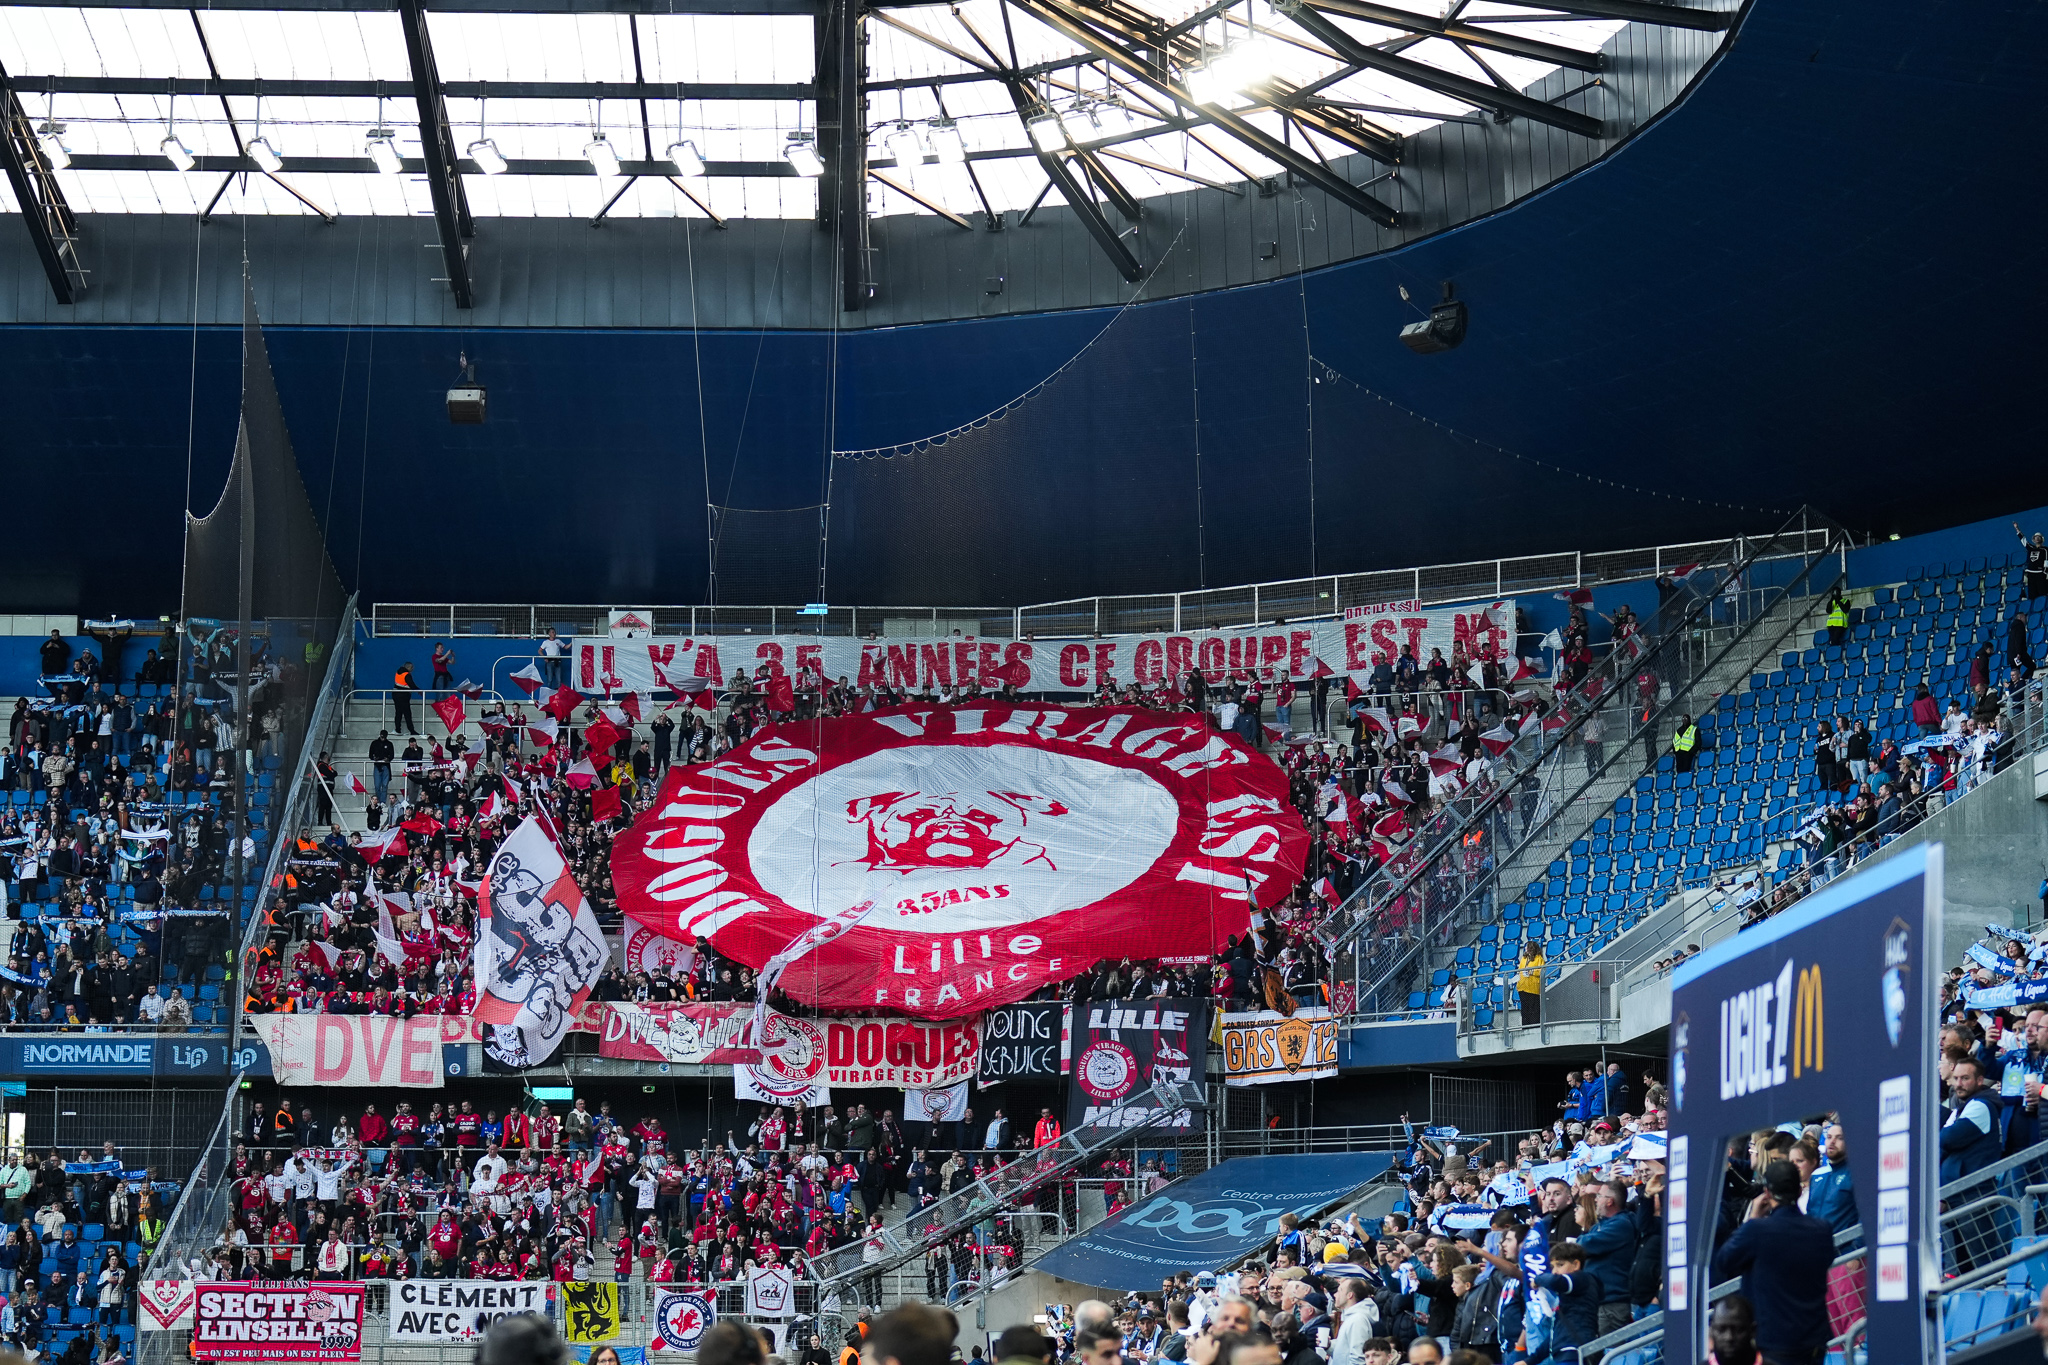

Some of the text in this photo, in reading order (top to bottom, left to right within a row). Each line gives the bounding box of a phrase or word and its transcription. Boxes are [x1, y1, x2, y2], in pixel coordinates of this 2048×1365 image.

[581, 645, 623, 688] IL
[856, 637, 1033, 689] ANNÉES
[1059, 643, 1117, 688] CE
[1134, 630, 1311, 686] GROUPE
[1345, 618, 1428, 670] EST
[643, 709, 1285, 939] DOGUES VIRAGE EST
[894, 934, 1043, 975] Lille
[875, 957, 1062, 1007] FRANCE
[605, 1011, 667, 1046] DVE
[985, 1009, 1050, 1040] YOUNG
[1088, 1009, 1190, 1031] LILLE
[30, 1045, 151, 1063] NORMANDIE
[313, 1013, 435, 1085] DVE
[813, 1039, 824, 1061] EST
[828, 1013, 978, 1069] DOGUES
[1225, 1020, 1338, 1071] GRS 12
[984, 1045, 1056, 1076] SERVICE
[1095, 1042, 1126, 1054] VIRAGE
[1126, 1055, 1136, 1070] EST
[829, 1056, 978, 1084] VIRAGE EST 1989
[1090, 1088, 1112, 1098] LILLE
[1221, 1189, 1273, 1200] Centre
[251, 1280, 310, 1289] LILLE FANS
[400, 1283, 538, 1307] CLÉMENT
[200, 1292, 359, 1319] SECTIN
[199, 1320, 358, 1341] LINSELLES
[397, 1311, 461, 1334] AVEC
[242, 1350, 260, 1358] PEU
[262, 1350, 284, 1358] MAIS
[320, 1335, 354, 1349] 1999
